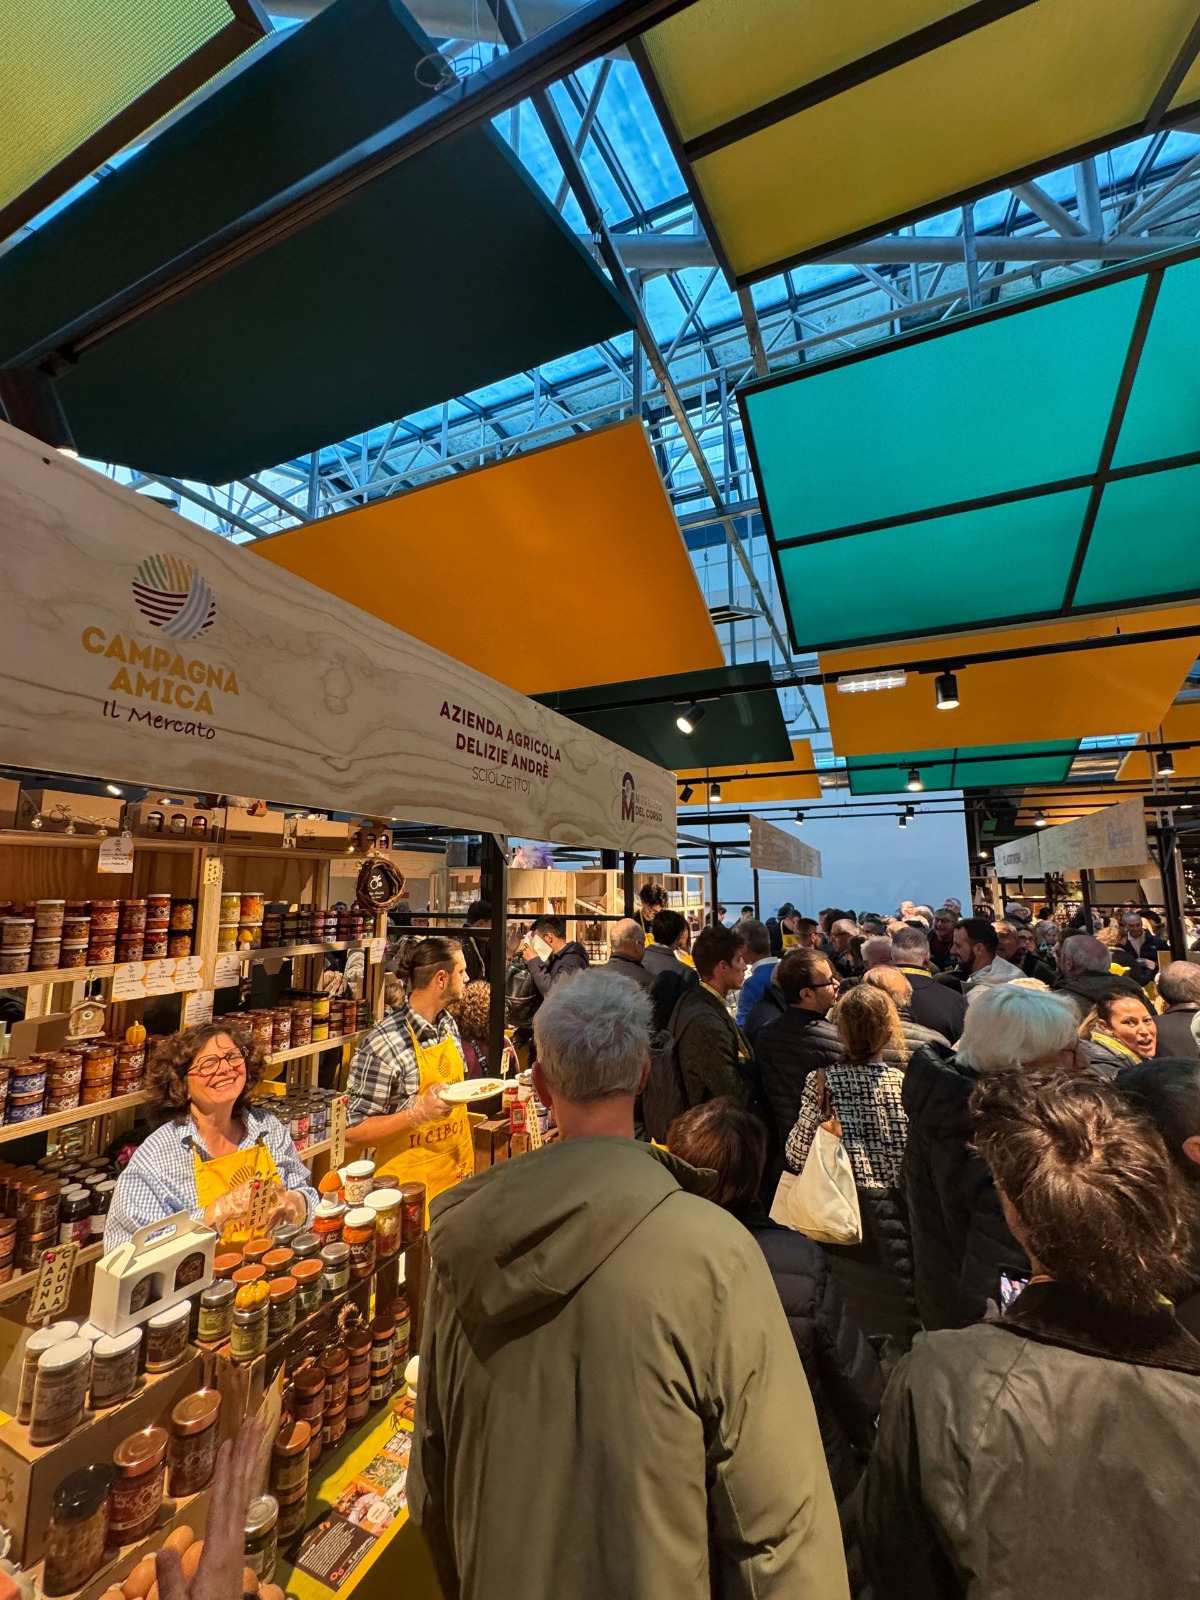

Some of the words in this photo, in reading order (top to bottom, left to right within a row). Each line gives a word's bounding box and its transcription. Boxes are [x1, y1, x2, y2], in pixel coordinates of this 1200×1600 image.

[81, 626, 240, 696] CAMPAGNA
[110, 666, 214, 715] AMICA
[128, 707, 216, 740] Mercato
[439, 701, 503, 740] AZIENDA
[506, 729, 562, 762] AGRICOLA
[456, 732, 508, 765] DELIZIE
[511, 754, 549, 779] ANDRÈ
[472, 766, 512, 790] SCIOLZE
[635, 805, 645, 818] DEL
[646, 808, 663, 822] CORSO
[425, 1121, 459, 1144] CIBO
[250, 1187, 260, 1226] ALSE
[259, 1180, 269, 1223] PESTI
[37, 1258, 56, 1313] AGNA
[51, 1250, 72, 1308] CAUDA
